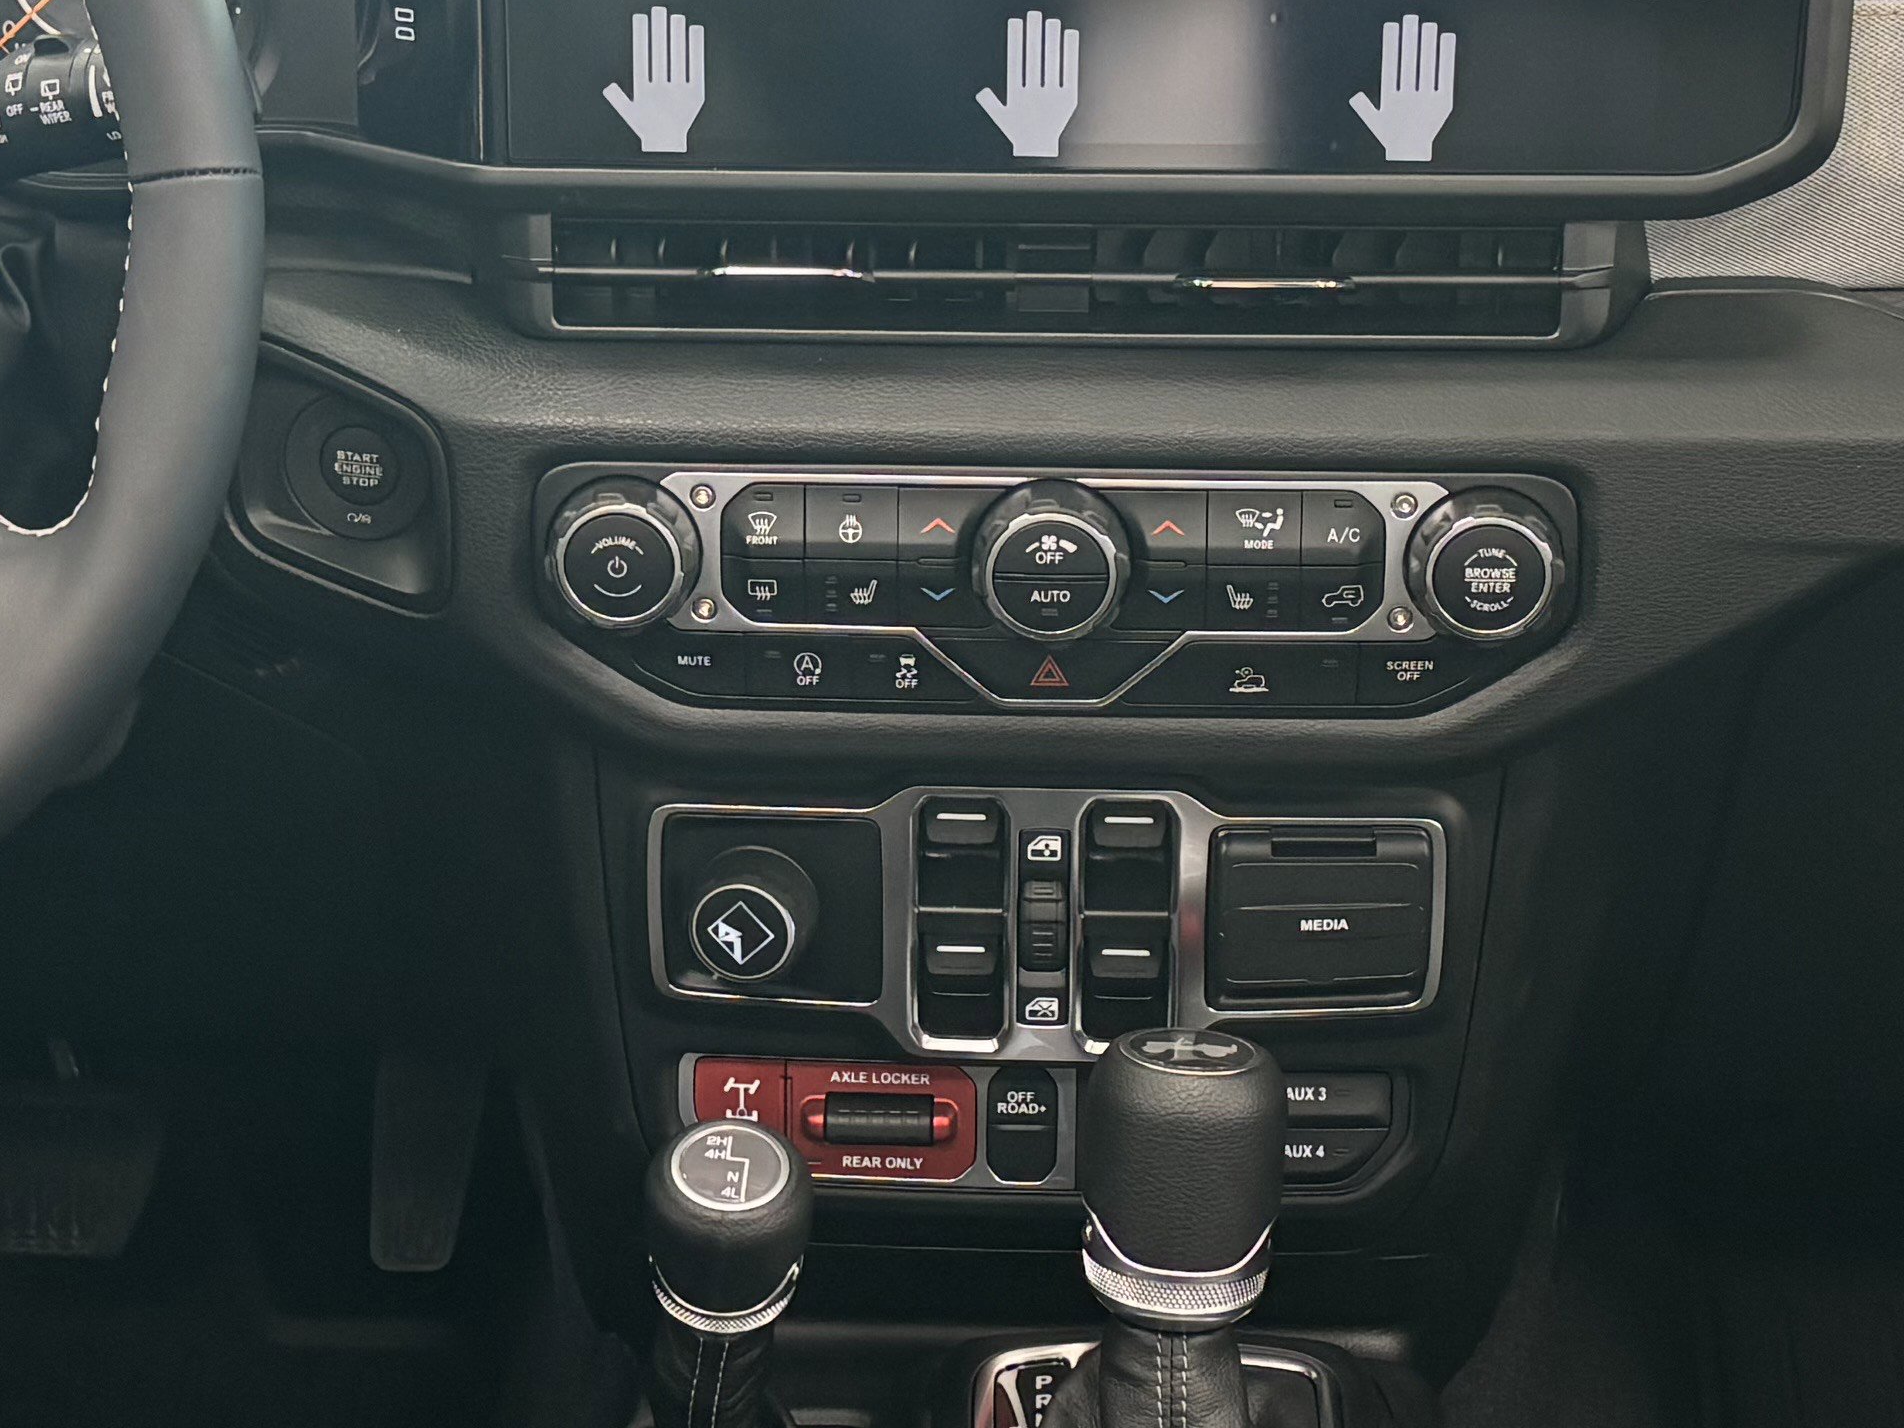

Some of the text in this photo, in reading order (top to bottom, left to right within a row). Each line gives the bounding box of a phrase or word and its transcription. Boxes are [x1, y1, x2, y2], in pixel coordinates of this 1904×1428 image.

[395, 7, 415, 42] DO
[6, 104, 24, 118] OFF
[336, 450, 380, 465] START
[334, 462, 384, 477] ENGINE
[342, 475, 379, 488] STOP
[745, 534, 779, 547] FRONT
[1326, 527, 1361, 545] A/C
[594, 536, 637, 552] VOLUME
[1243, 538, 1275, 551] MODE
[1034, 549, 1065, 564] OFF
[1464, 567, 1517, 580] BROWSE
[1470, 581, 1511, 594] ENTER
[1029, 588, 1071, 605] AUTO
[1469, 597, 1511, 613] SCROLL
[677, 655, 713, 667] MUTE
[1386, 659, 1435, 672] SCREEN
[796, 675, 821, 687] OFF
[1396, 670, 1421, 682] OFF
[895, 678, 919, 690] OFF
[1299, 917, 1350, 933] MEDIA
[830, 1070, 930, 1086] AXLE LOCKER
[1007, 1091, 1036, 1104] OFF
[1286, 1086, 1328, 1102] AUX 3
[706, 1135, 728, 1146] 2H
[704, 1148, 726, 1160] 4H
[1284, 1144, 1325, 1158] AUX 4
[842, 1155, 924, 1171] REAR ONLY
[726, 1170, 740, 1183] N
[720, 1186, 740, 1199] 4L
[1035, 1375, 1053, 1390] P
[1035, 1393, 1053, 1409] R
